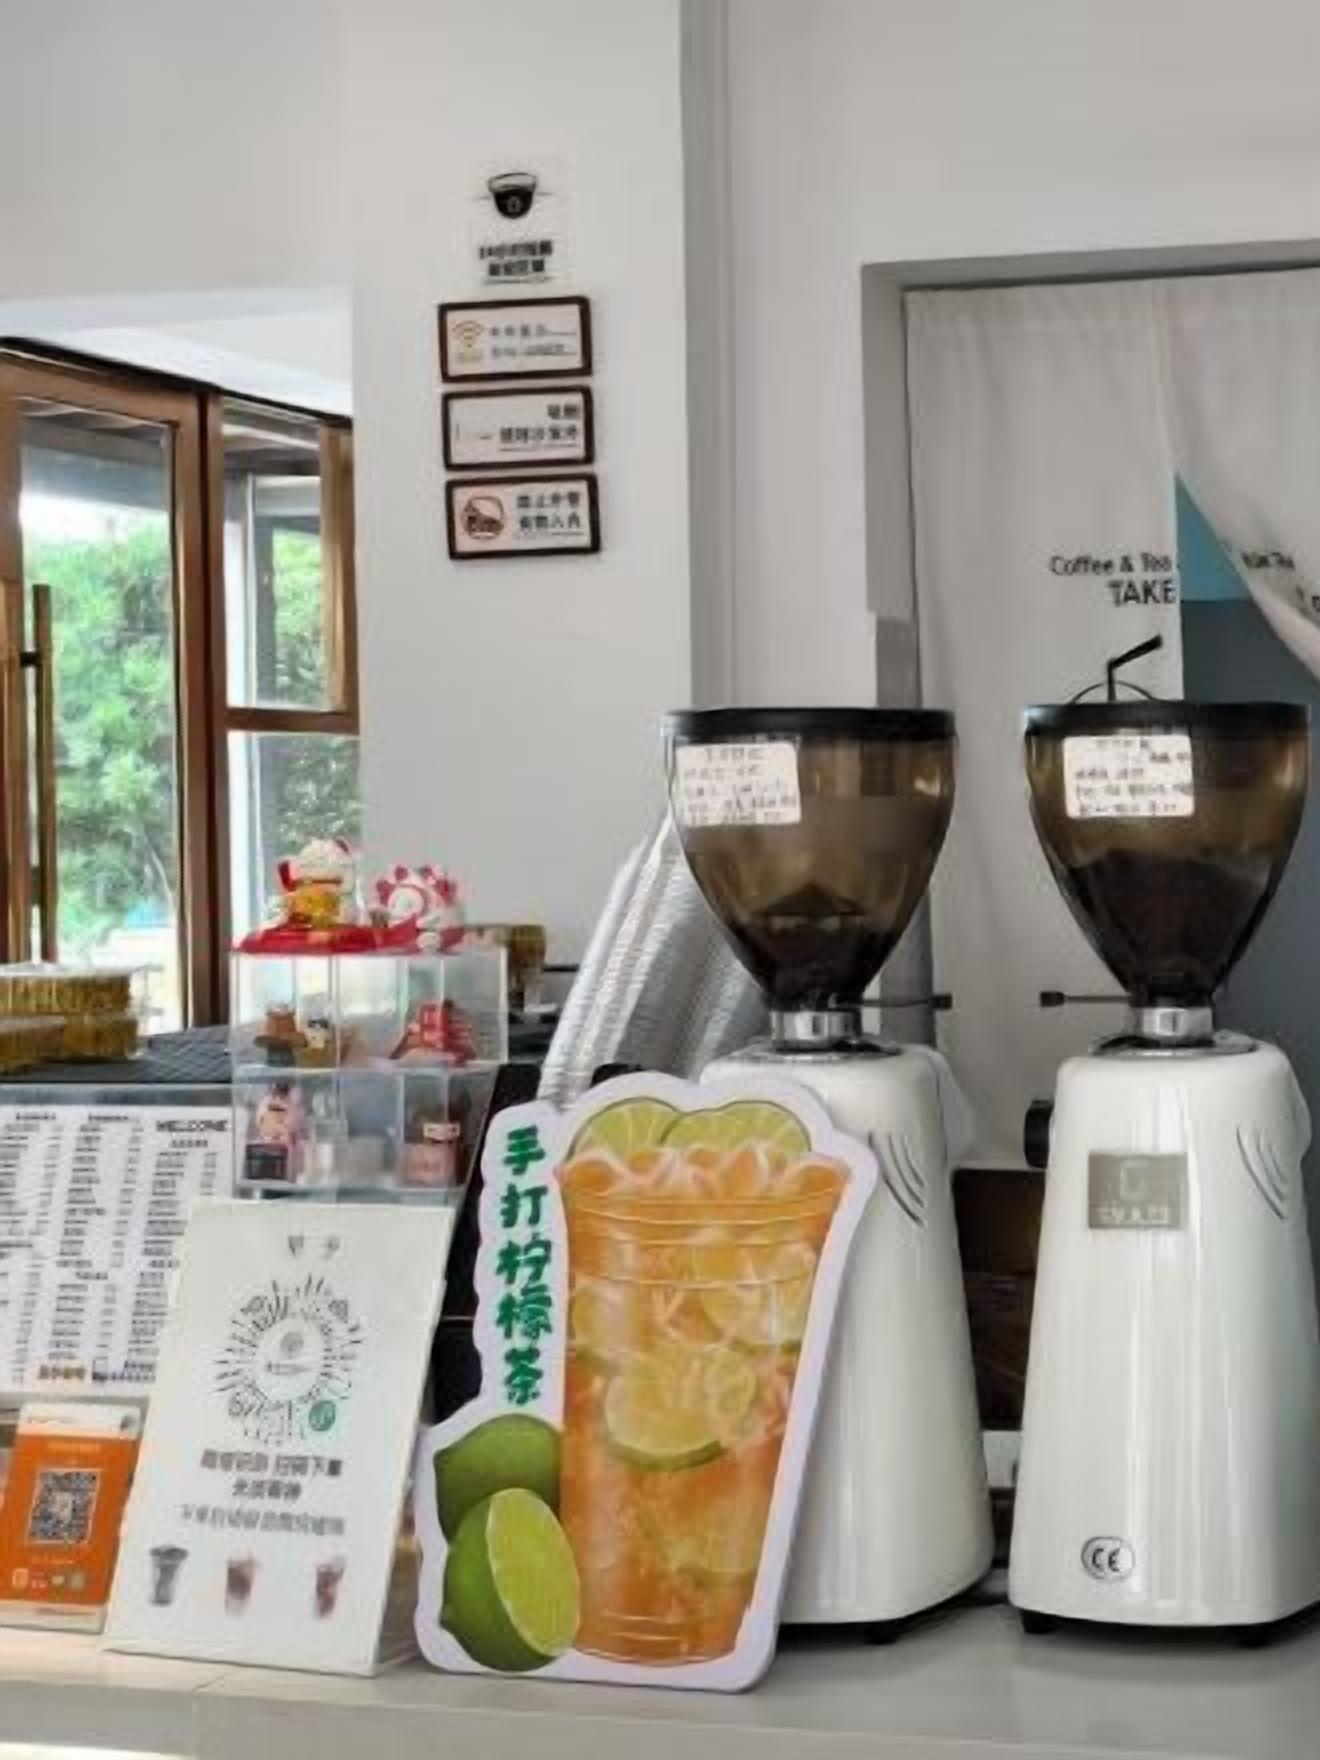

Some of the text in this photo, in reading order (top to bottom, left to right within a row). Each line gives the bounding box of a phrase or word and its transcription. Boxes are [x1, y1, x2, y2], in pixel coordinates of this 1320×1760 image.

[1051, 556, 1113, 575] Coffee
[1119, 556, 1134, 572] &
[1107, 578, 1176, 607] TAKE
[495, 1125, 553, 1406] 手打柠檬茶
